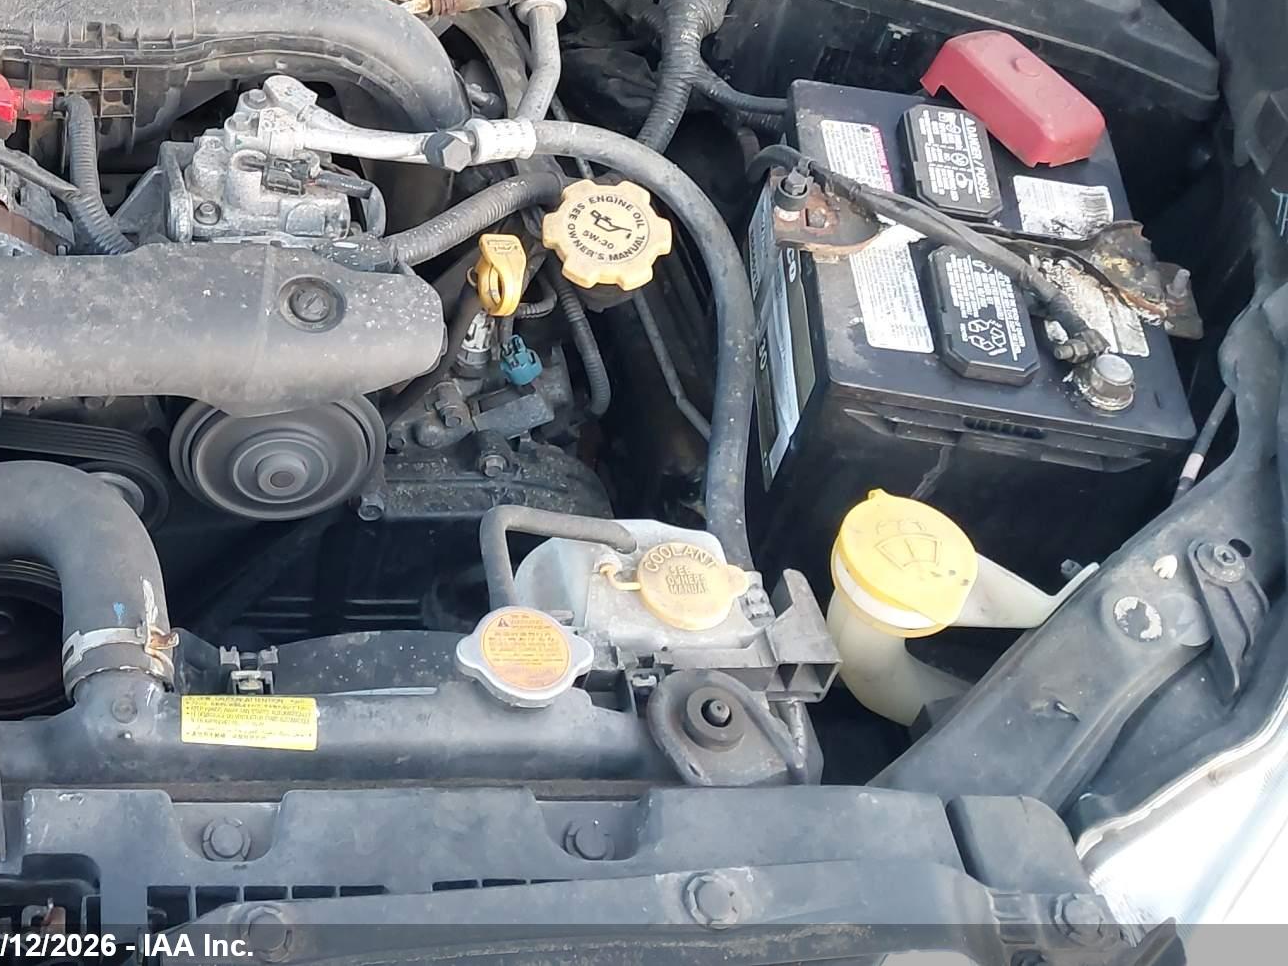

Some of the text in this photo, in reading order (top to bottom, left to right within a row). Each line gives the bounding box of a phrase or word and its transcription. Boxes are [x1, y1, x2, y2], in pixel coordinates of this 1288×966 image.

[966, 125, 983, 160] DANGER
[975, 166, 992, 199] POISON
[588, 194, 646, 230] ENGINE OIL
[567, 202, 646, 262] SEE OWNER'S MANUAL
[582, 229, 615, 250] 5W-30
[643, 545, 717, 572] COOLANT
[669, 564, 692, 576] SEE
